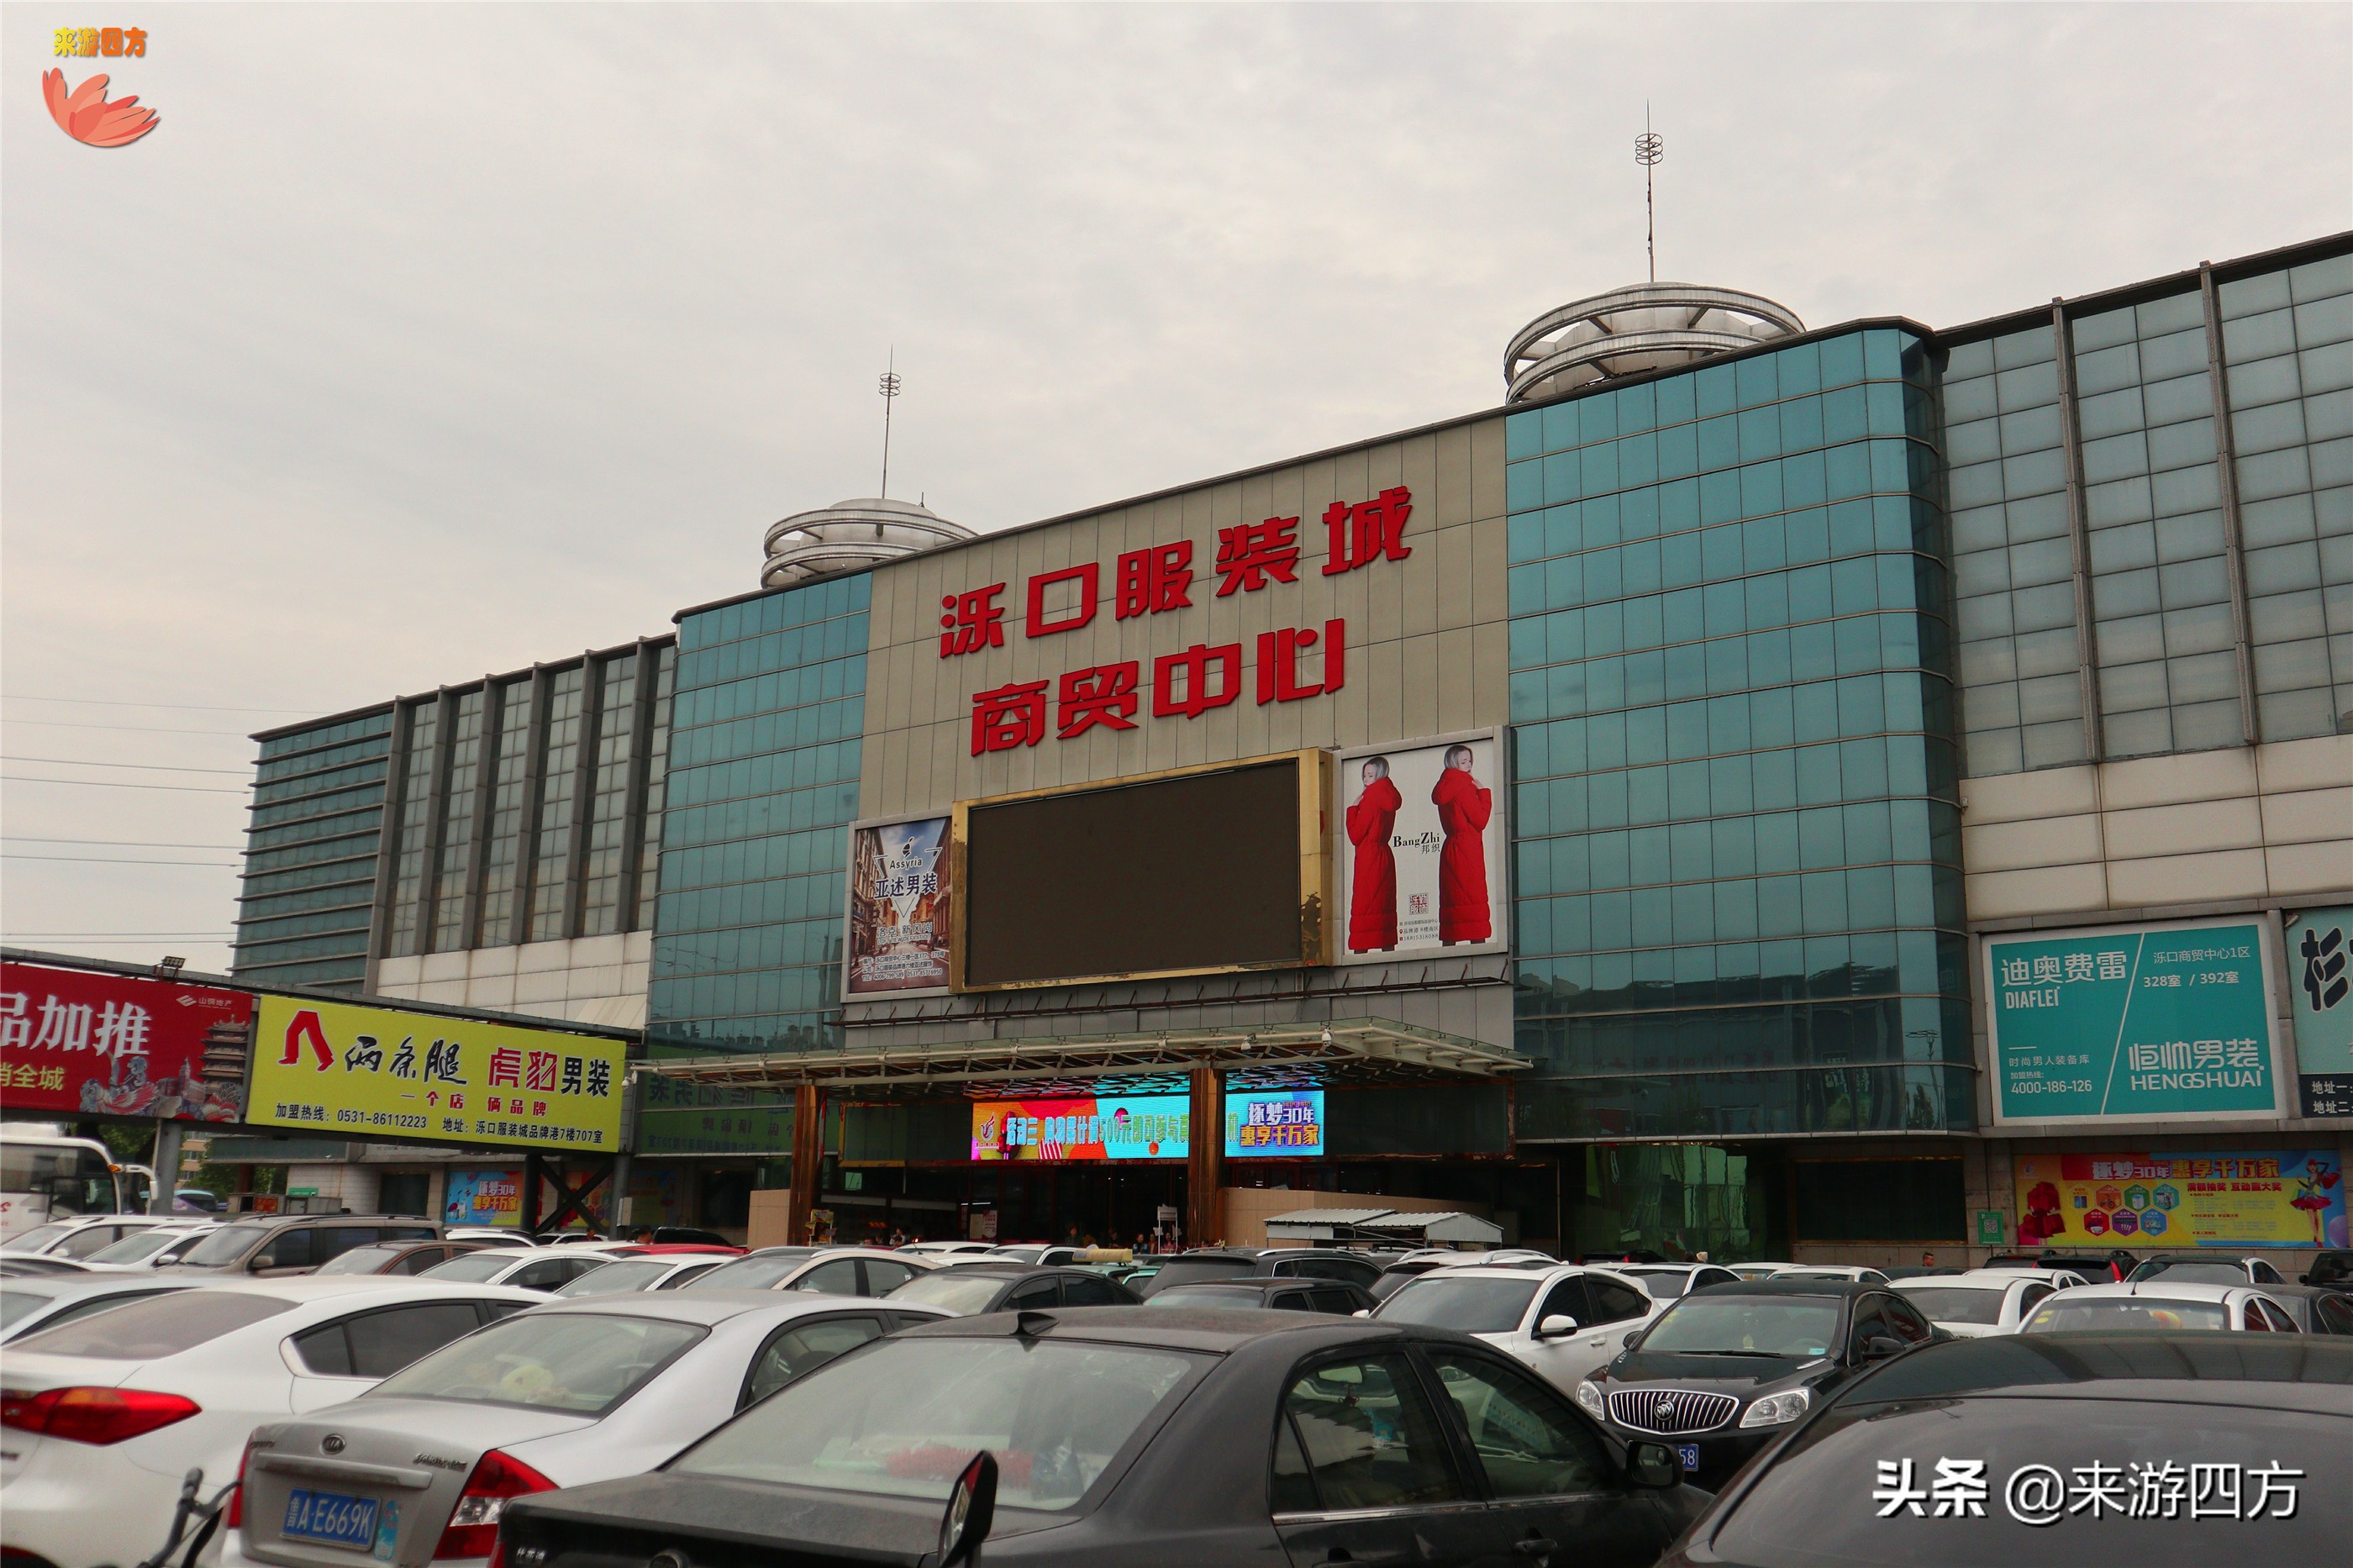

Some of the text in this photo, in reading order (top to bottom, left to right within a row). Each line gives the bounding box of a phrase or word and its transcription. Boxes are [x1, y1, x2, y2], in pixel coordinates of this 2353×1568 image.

[940, 486, 1412, 659] 泺口服装城
[971, 618, 1345, 758] 商贸中心
[1421, 844, 1440, 855] 邦织
[889, 856, 923, 871] Assyria
[875, 873, 938, 899] 亚述男装
[2153, 946, 2250, 965] 泺口商贸中心1区
[2001, 950, 2127, 988] 迪奥费雷
[2144, 974, 2182, 988] 328室
[2200, 971, 2240, 985] 392室
[2300, 928, 2353, 1011] 杉
[2005, 986, 2061, 1009] DIAFLEI
[2008, 1054, 2091, 1068] 时尚男人装备库
[2129, 1038, 2260, 1071] 恒帅男装
[2011, 1080, 2092, 1094] 4000-186-126
[2131, 1065, 2264, 1091] HENGSHUAI
[400, 1091, 548, 1116] 一个店 俩品牌
[1248, 1102, 1314, 1126] 逐梦30年
[337, 1109, 427, 1129] 0531-86112223
[1240, 1123, 1319, 1146] 惠享千万家
[2171, 1158, 2280, 1179] 惠享千万家
